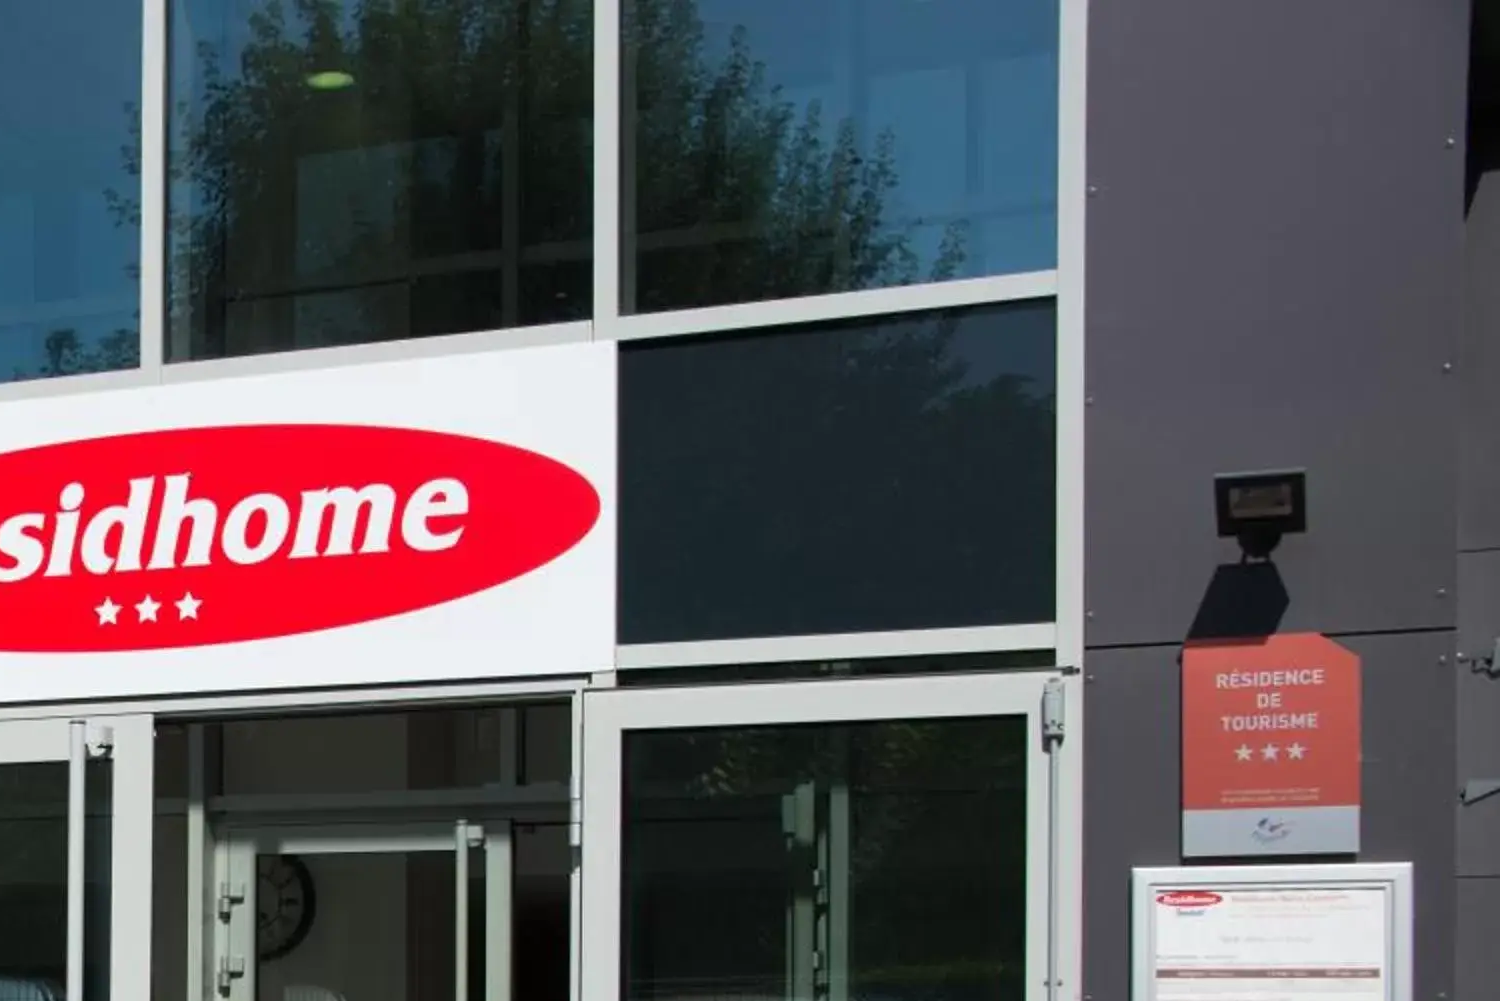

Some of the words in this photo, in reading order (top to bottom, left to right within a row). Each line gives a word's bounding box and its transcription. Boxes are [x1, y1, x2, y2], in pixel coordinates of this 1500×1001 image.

[1216, 668, 1325, 689] RÉSIDENCE
[1257, 692, 1282, 709] DE
[1221, 712, 1318, 731] TOURISME
